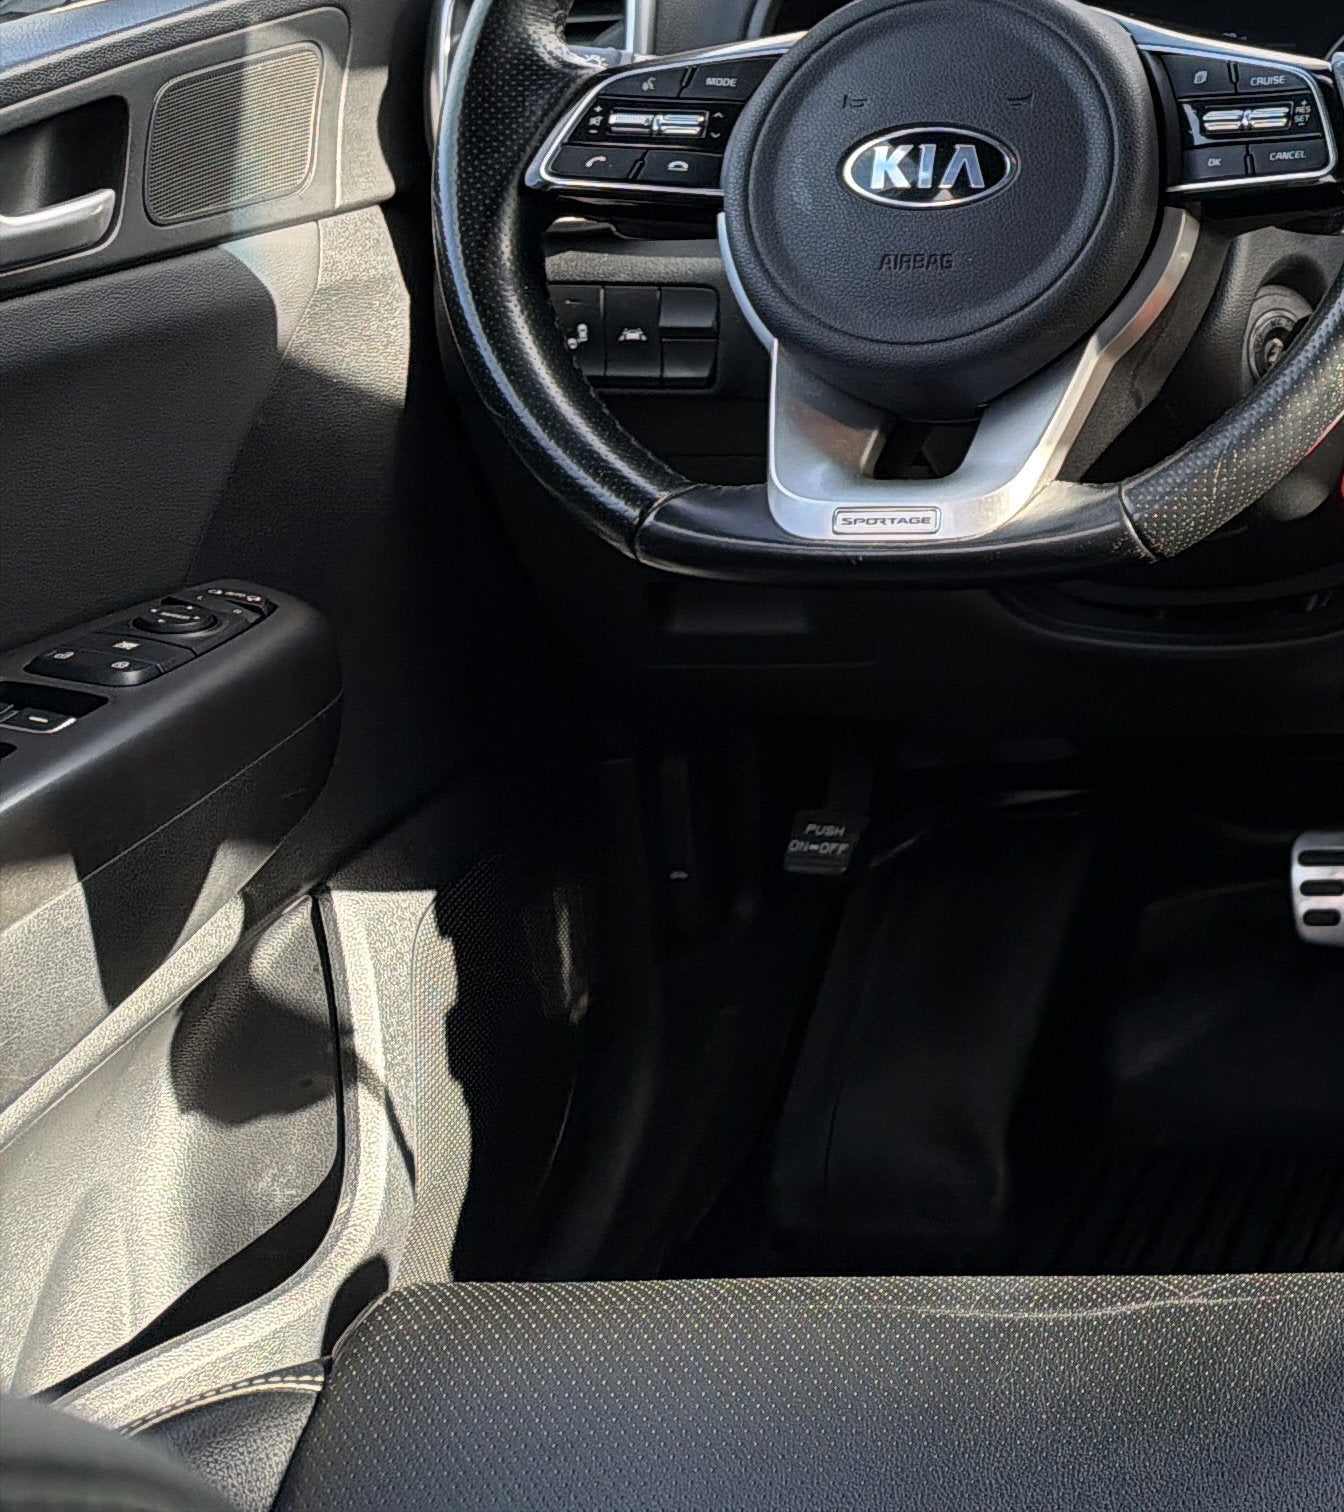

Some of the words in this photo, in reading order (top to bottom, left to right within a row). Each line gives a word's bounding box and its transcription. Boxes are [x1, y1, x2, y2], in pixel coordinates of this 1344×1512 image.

[706, 77, 738, 87] MODE
[1250, 74, 1286, 86] CRUISE
[1295, 106, 1311, 114] RES
[1294, 114, 1310, 123] SET
[1269, 150, 1307, 161] CANCEL
[870, 143, 986, 190] KIA
[1208, 157, 1222, 167] OK
[878, 253, 953, 271] AIRBAG
[840, 516, 932, 526] SPORTAGE
[804, 823, 846, 837] PUSH
